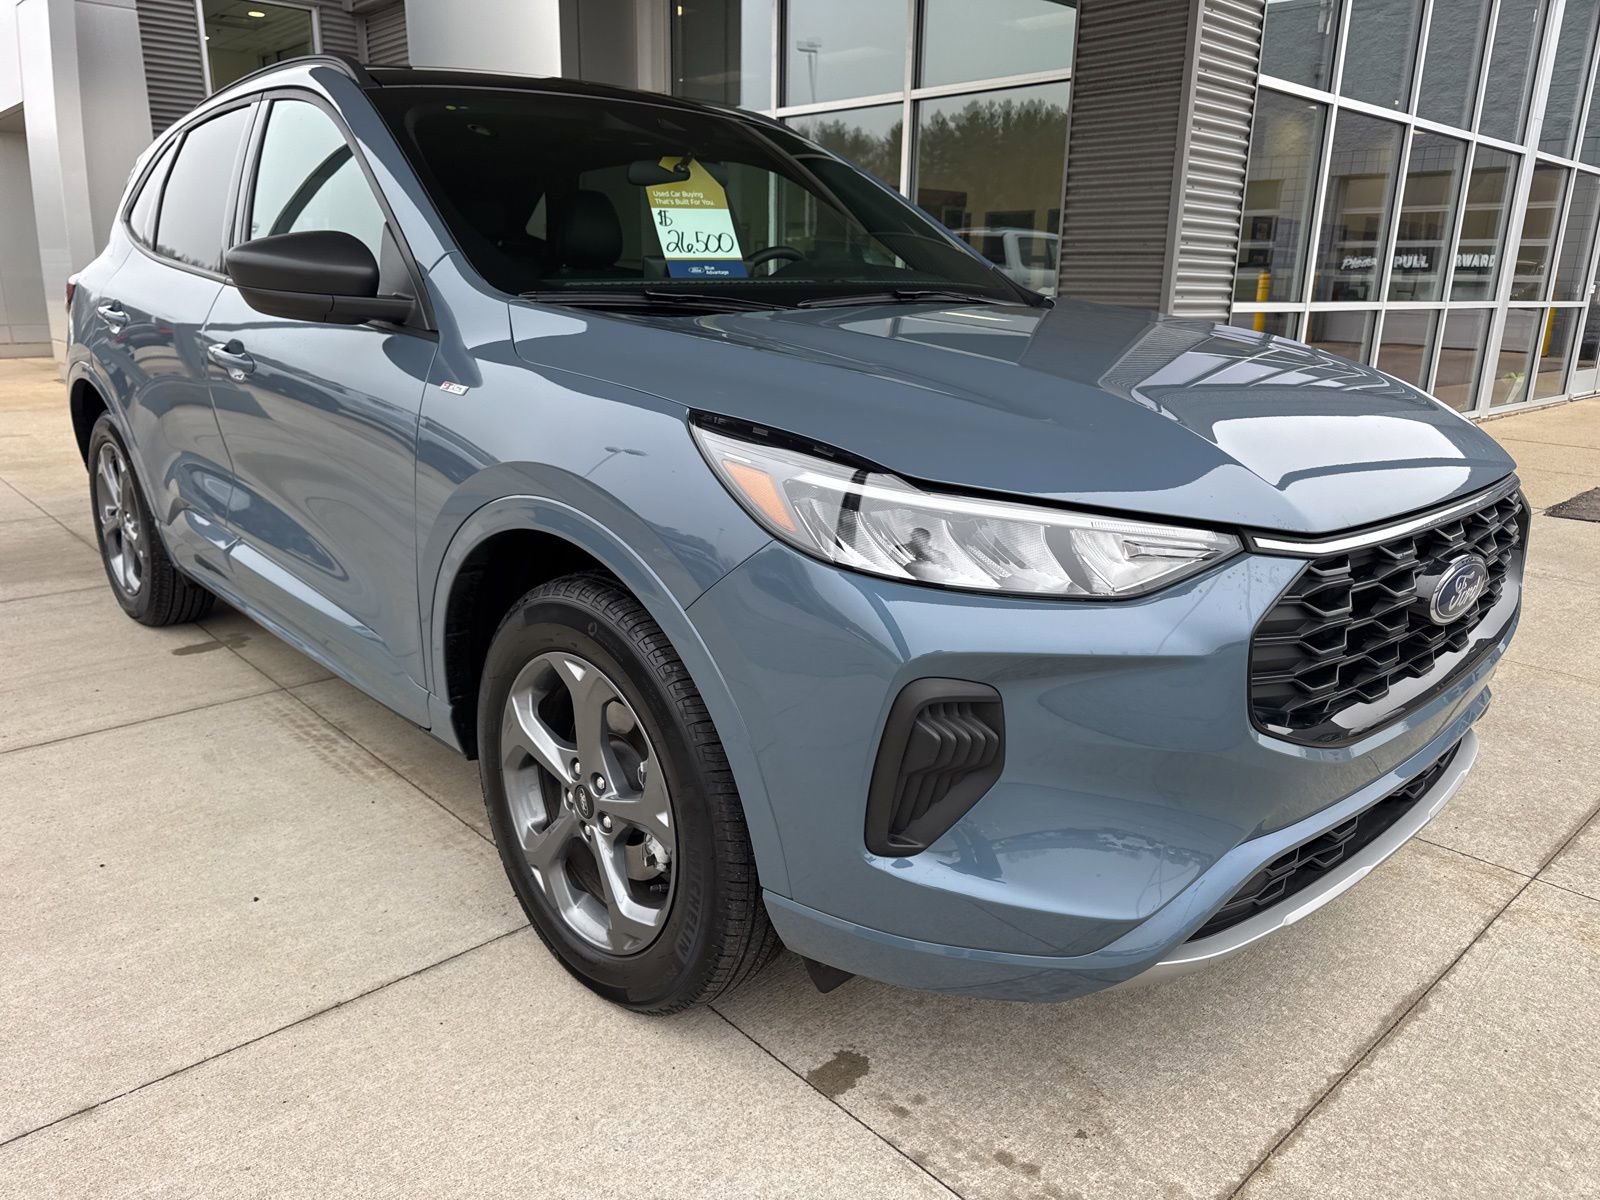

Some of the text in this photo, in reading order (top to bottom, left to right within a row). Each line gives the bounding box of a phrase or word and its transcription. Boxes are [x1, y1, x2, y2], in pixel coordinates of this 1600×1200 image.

[682, 191, 704, 199] Buying
[1393, 254, 1428, 269] PULL
[1454, 254, 1496, 268] RWARD
[1448, 570, 1482, 612] Ford
